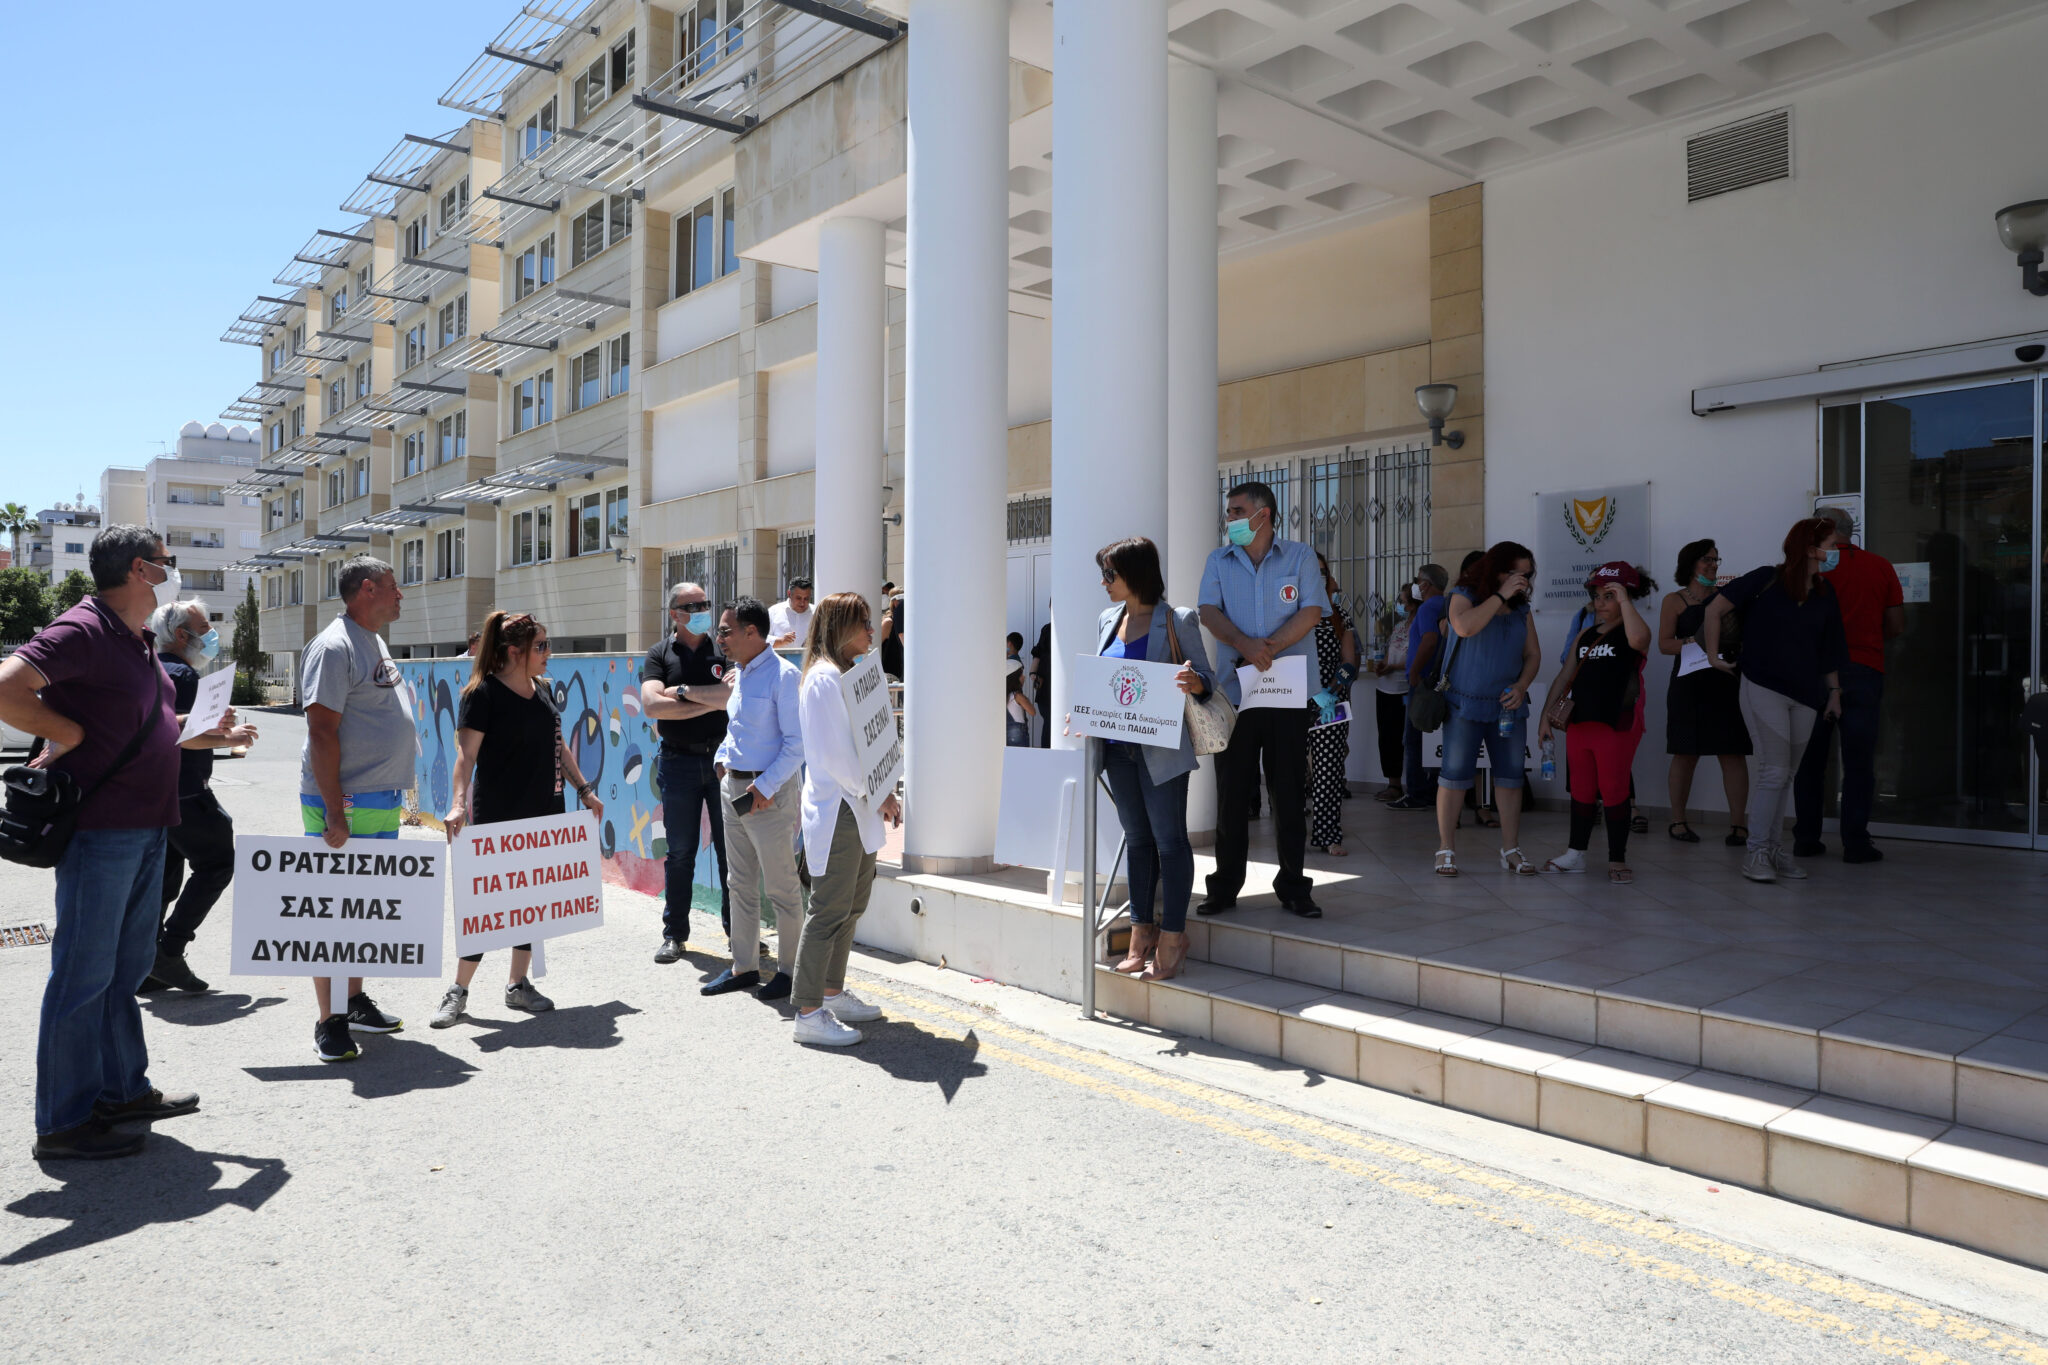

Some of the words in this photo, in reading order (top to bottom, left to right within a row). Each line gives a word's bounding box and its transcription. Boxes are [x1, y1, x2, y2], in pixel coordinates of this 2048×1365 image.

[853, 682, 861, 704] Η
[858, 664, 882, 700] ΠΑΙΔΕΙΑ
[864, 720, 877, 747] ΣΑΣ
[876, 704, 890, 736] ΕΙΝΑΙ
[1074, 705, 1090, 714] ΙΣΕΣ
[1092, 709, 1122, 719] ευκαιρίες
[1124, 712, 1136, 720] ΙΣΑ
[1139, 714, 1178, 727] δικαιώματα
[1100, 720, 1116, 730] ΟΛΑ
[1128, 724, 1158, 736] ΠΑΙΔΙΑ!
[868, 774, 875, 796] Ο
[873, 739, 900, 790] ΡΑΤΣΙΣΜΟΣ
[472, 837, 495, 856] ΤΑ
[500, 825, 587, 853] ΚΟΝΔΥΛΙΑ
[252, 850, 271, 871] Ο
[279, 851, 435, 877] ΡΑΤΣΙΣΜΟΣ
[473, 874, 502, 895] ΓΙΑ
[506, 871, 528, 890] ΤΑ
[533, 861, 589, 886] ΠΑΙΔΙΑ
[280, 896, 333, 918] ΣΑΣ
[341, 898, 402, 920] ΜΑΣ
[463, 912, 505, 936] ΜΑΣ
[510, 904, 547, 927] ΠΟΥ
[551, 895, 599, 920] ΠΑΝΕ;
[251, 939, 424, 964] ΔΥΝΑΜΩΝΕΙ
